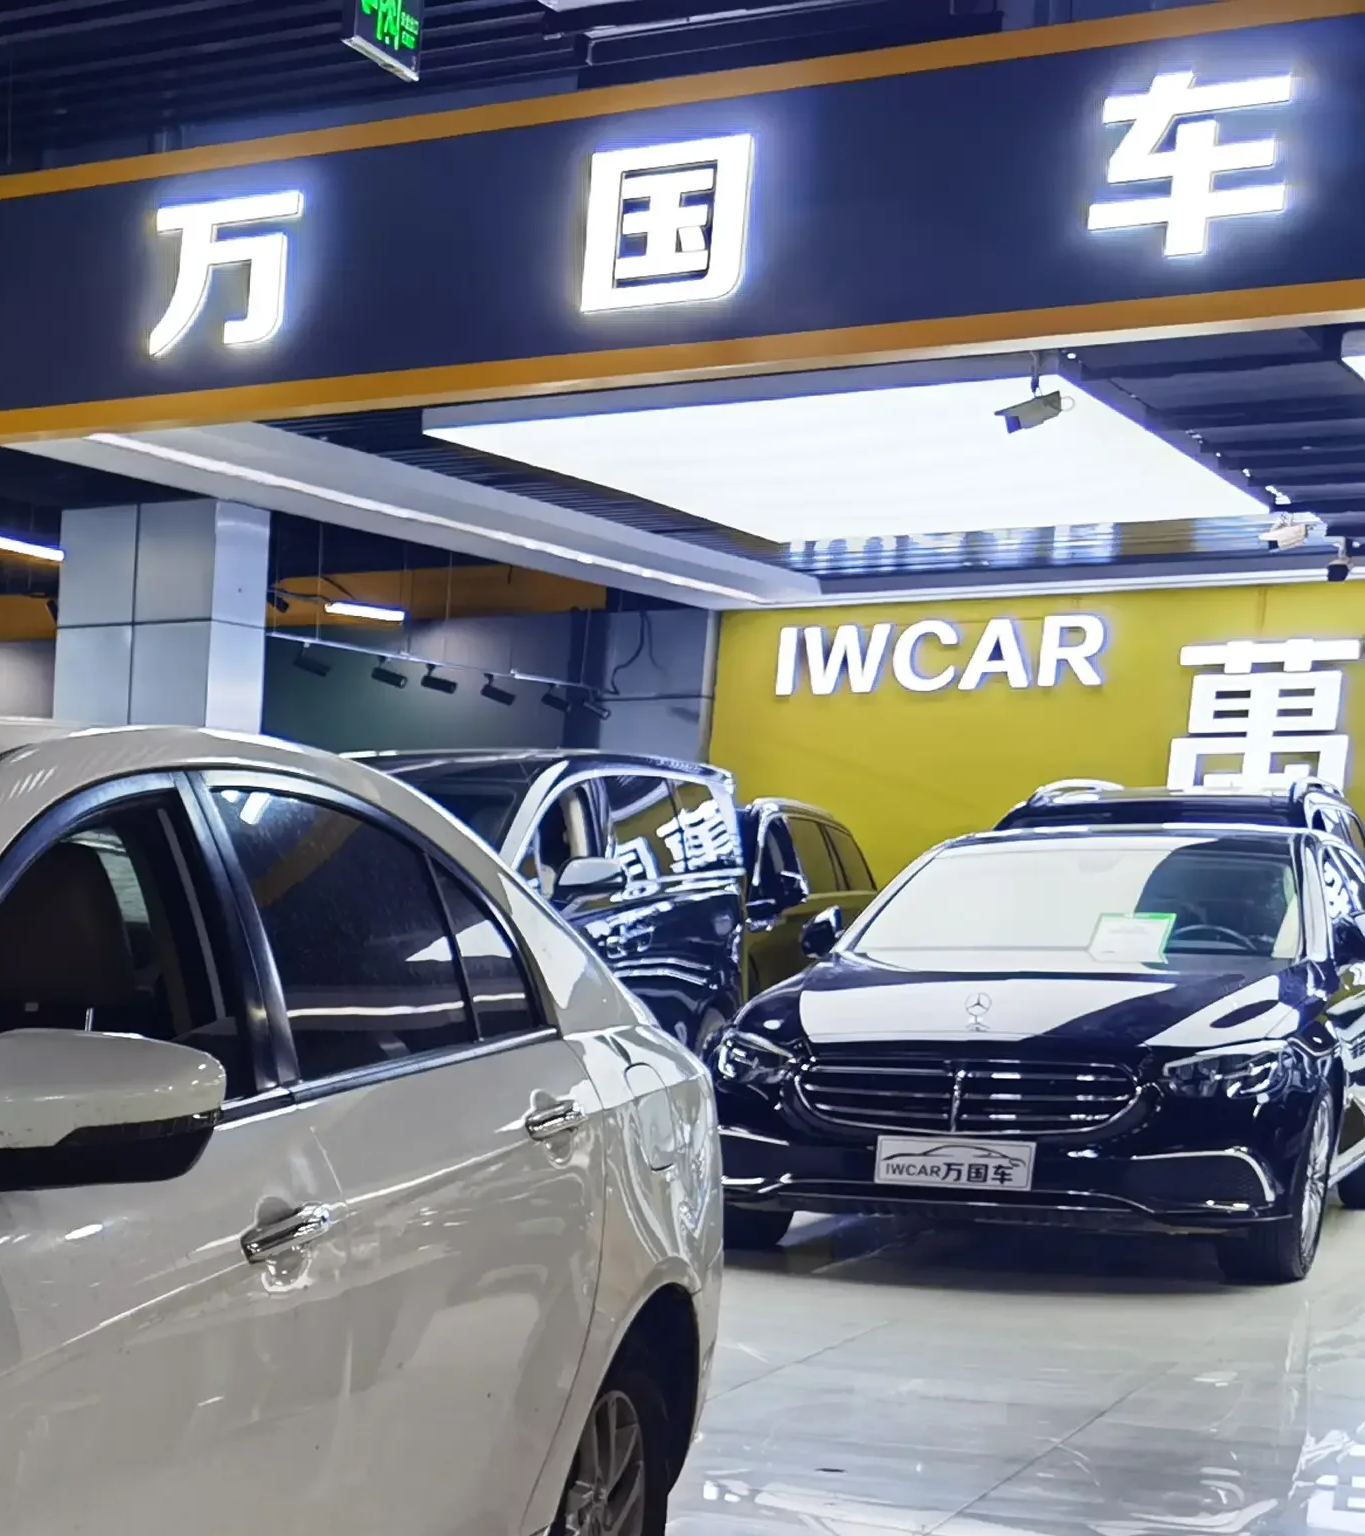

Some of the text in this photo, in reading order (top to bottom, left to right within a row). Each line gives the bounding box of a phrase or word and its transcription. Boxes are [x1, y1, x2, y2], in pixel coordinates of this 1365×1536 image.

[148, 67, 1295, 356] 万国车
[774, 614, 1106, 697] IWCAR
